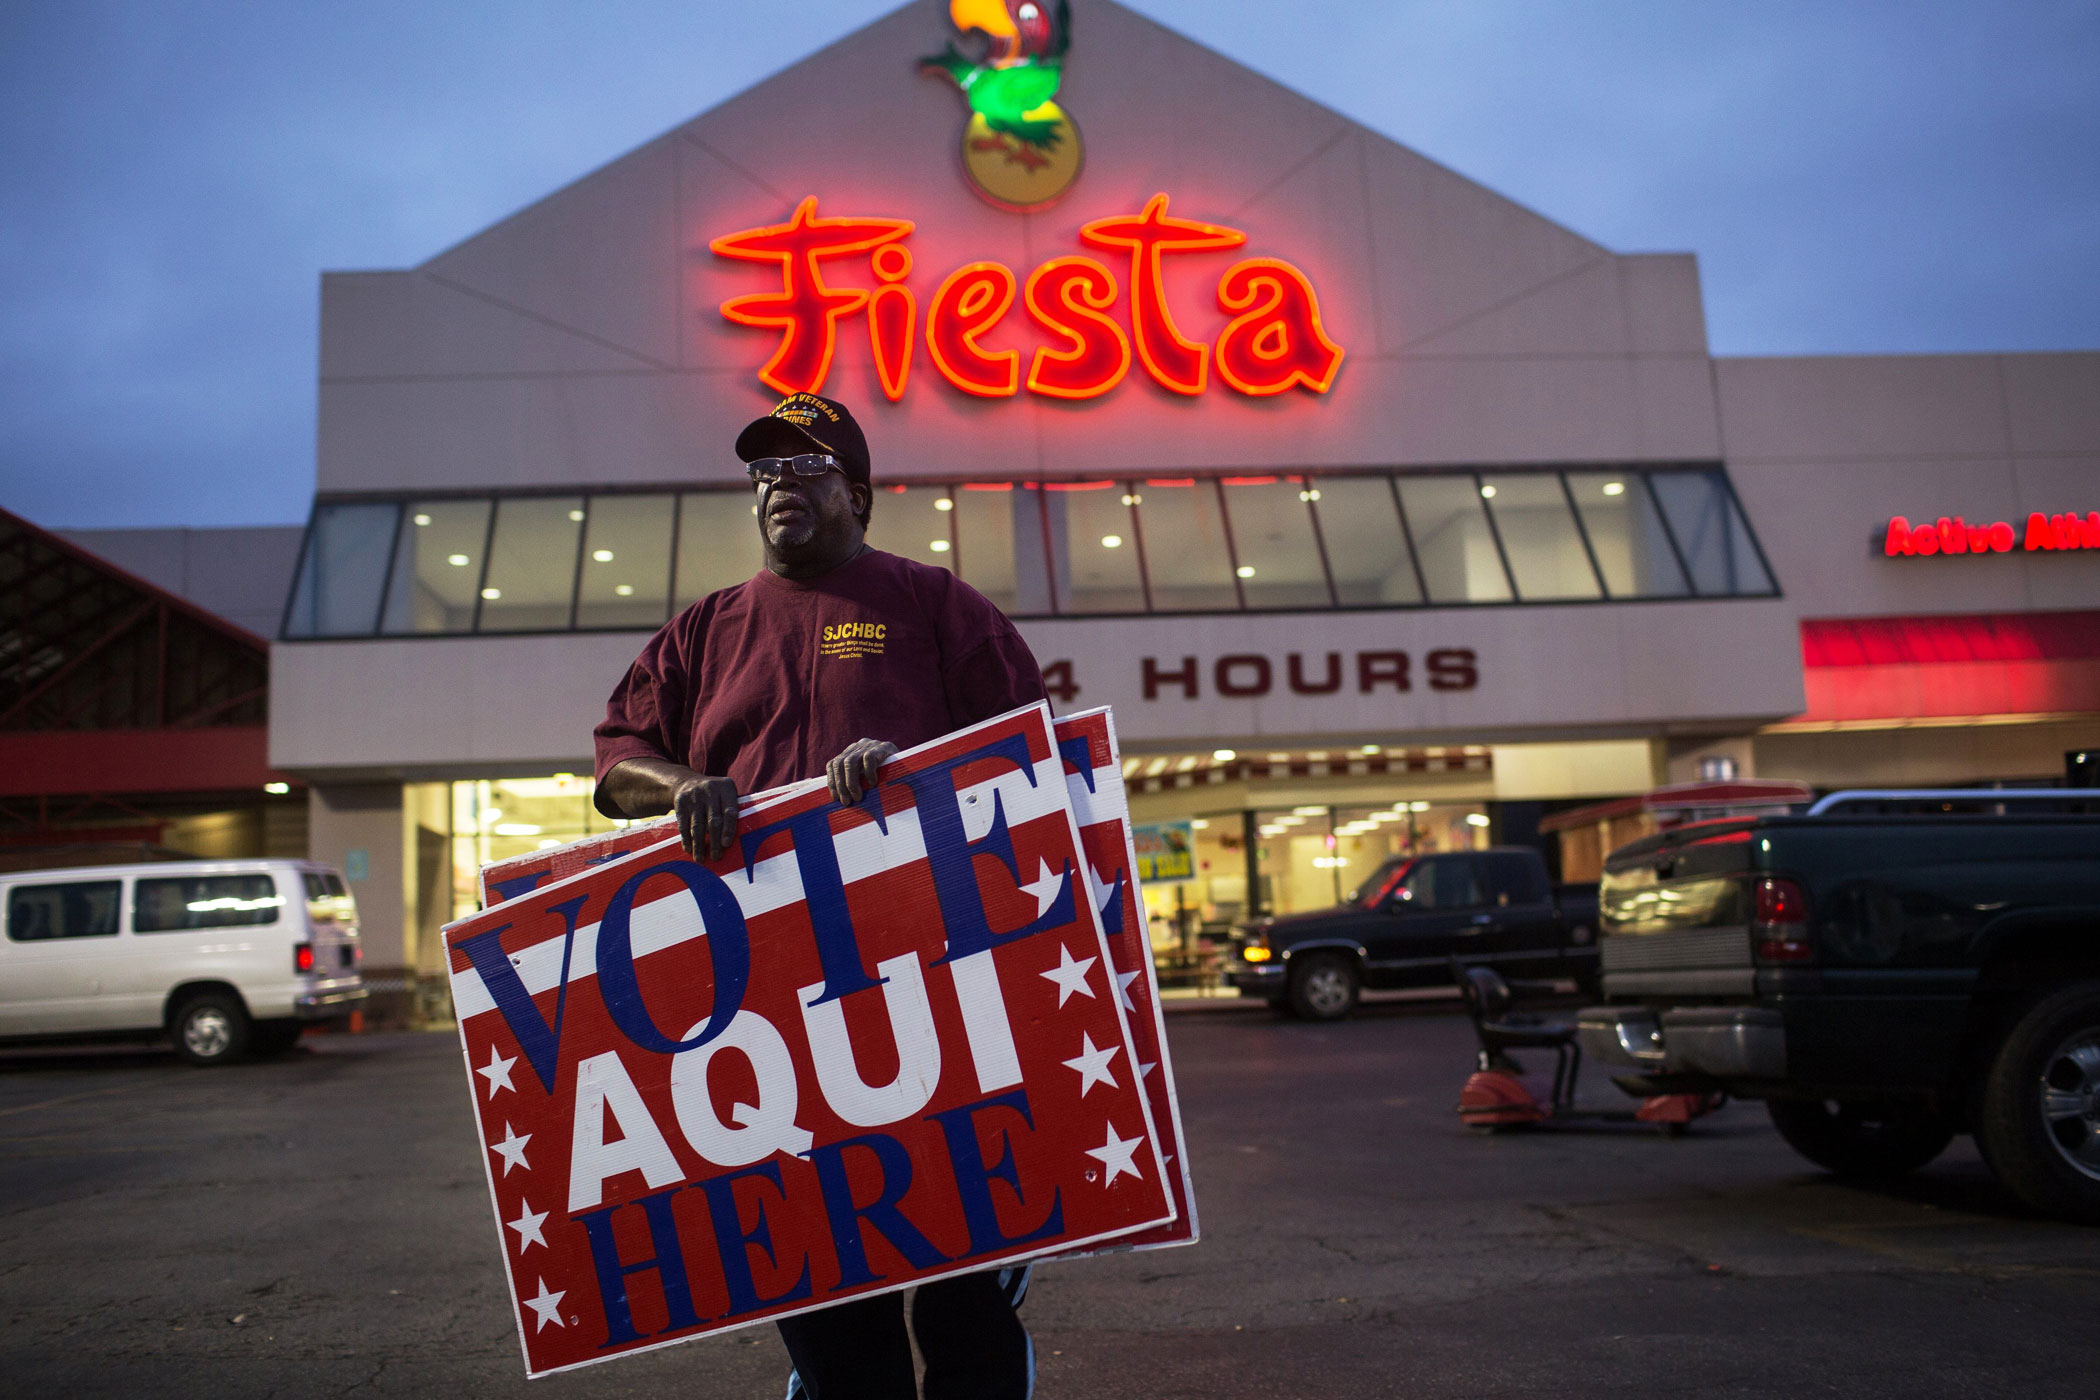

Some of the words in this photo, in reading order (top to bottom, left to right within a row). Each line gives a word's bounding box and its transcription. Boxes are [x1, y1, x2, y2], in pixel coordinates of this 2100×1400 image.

[709, 193, 1345, 401] Fiesta
[798, 393, 840, 422] VETERAN
[823, 622, 887, 641] SJCHBC
[1042, 659, 1081, 703] 4
[1141, 648, 1479, 701] HOURS
[452, 732, 1077, 1096] VOTE
[567, 940, 1023, 1213] AQUI
[571, 1089, 1065, 1350] HERE
